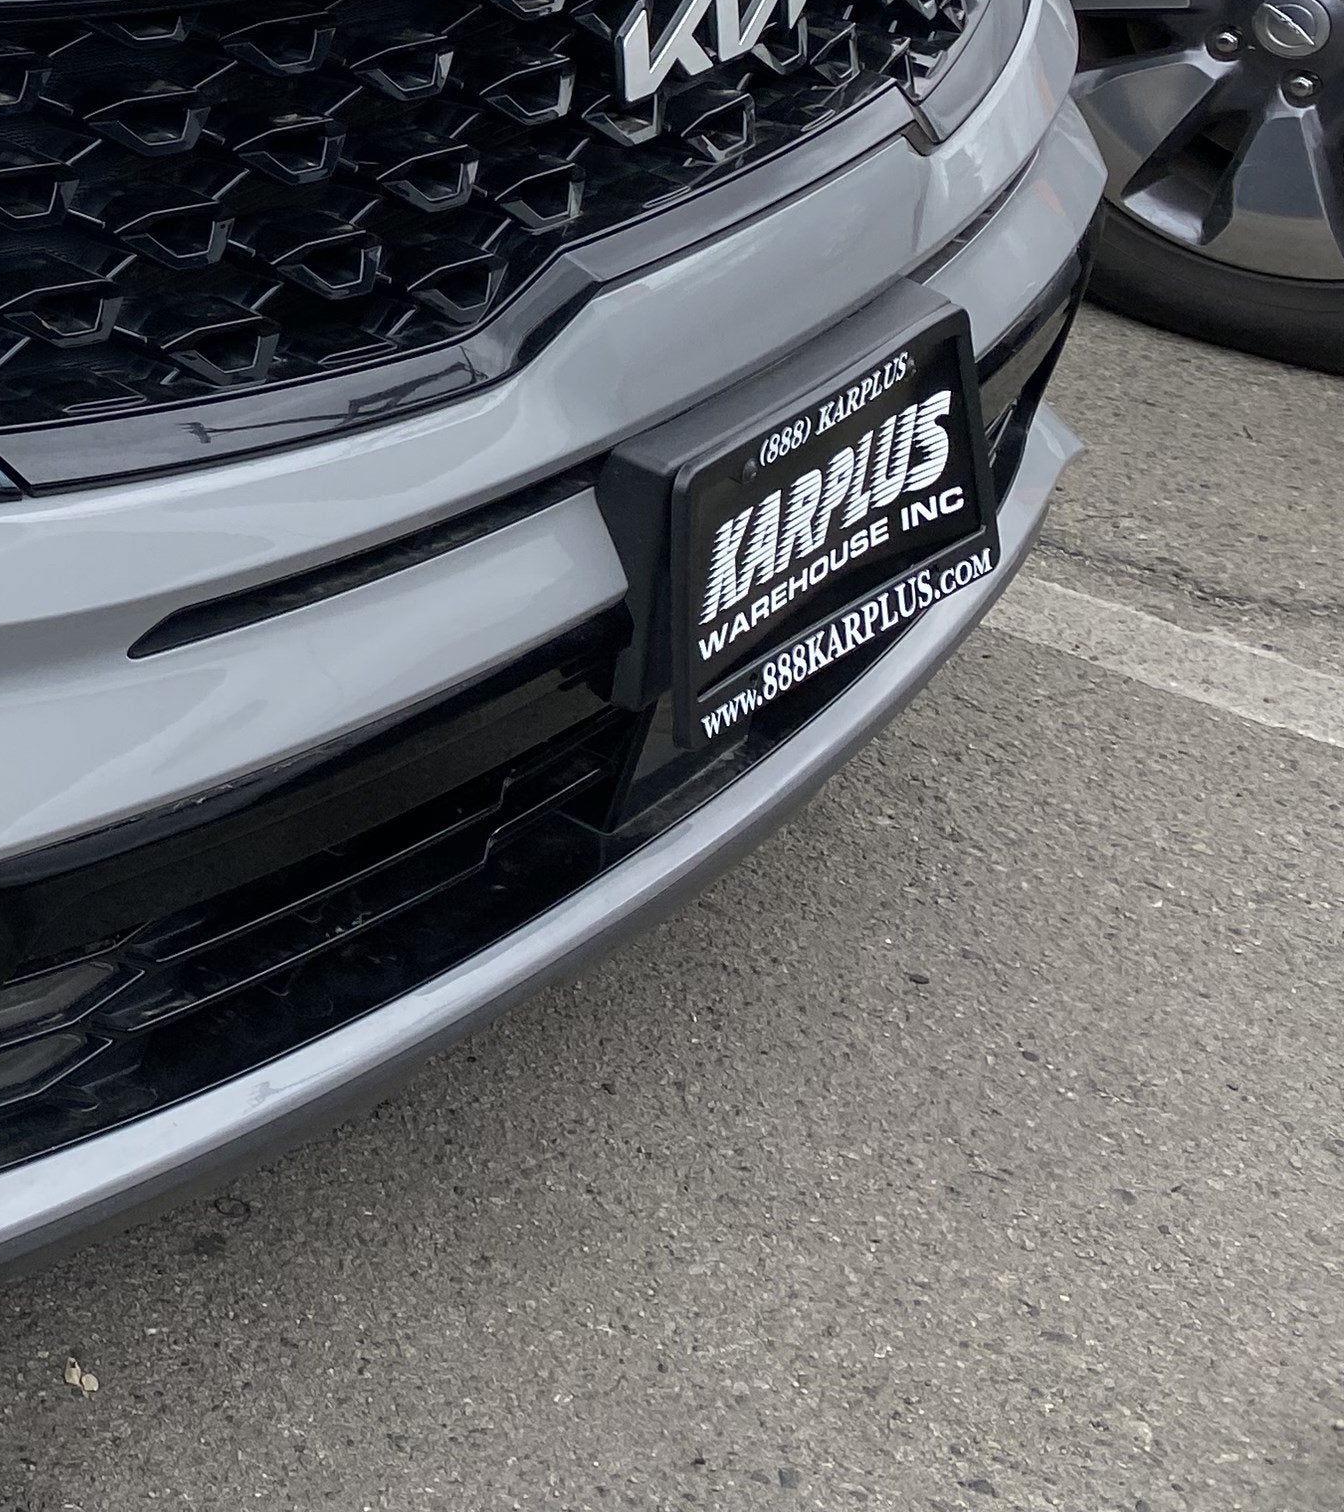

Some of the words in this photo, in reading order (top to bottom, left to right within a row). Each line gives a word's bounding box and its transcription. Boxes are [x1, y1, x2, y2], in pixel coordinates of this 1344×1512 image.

[759, 416, 812, 466] (888)
[814, 351, 908, 436] KARPLUS
[697, 517, 890, 661] WAREHOUSE
[901, 486, 964, 532] INC
[698, 390, 951, 626] KARPLUS
